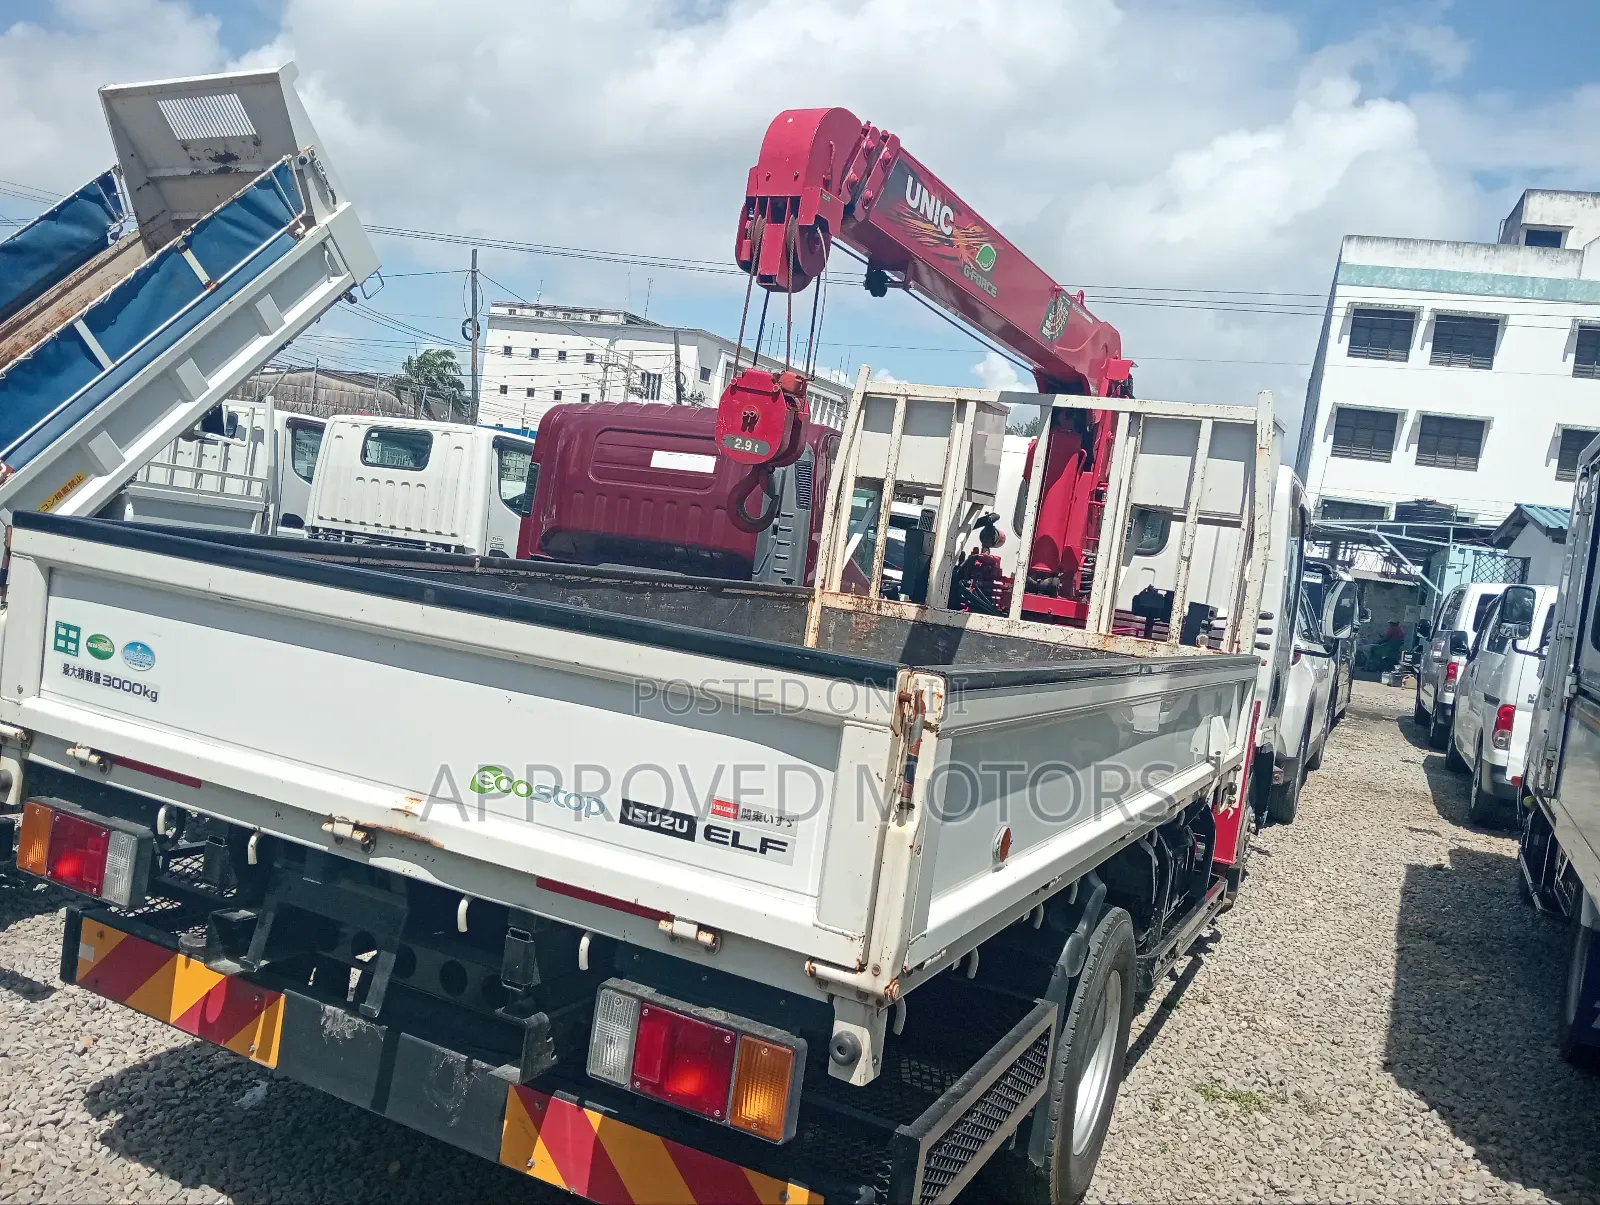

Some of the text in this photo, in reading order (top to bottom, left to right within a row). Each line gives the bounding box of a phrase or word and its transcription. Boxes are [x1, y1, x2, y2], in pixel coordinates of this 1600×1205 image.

[905, 174, 954, 235] UNIC
[734, 438, 752, 451] 2.9
[469, 766, 607, 818] ecostop
[713, 803, 737, 815] ISUZU
[627, 807, 789, 855] ISUZU ELF
